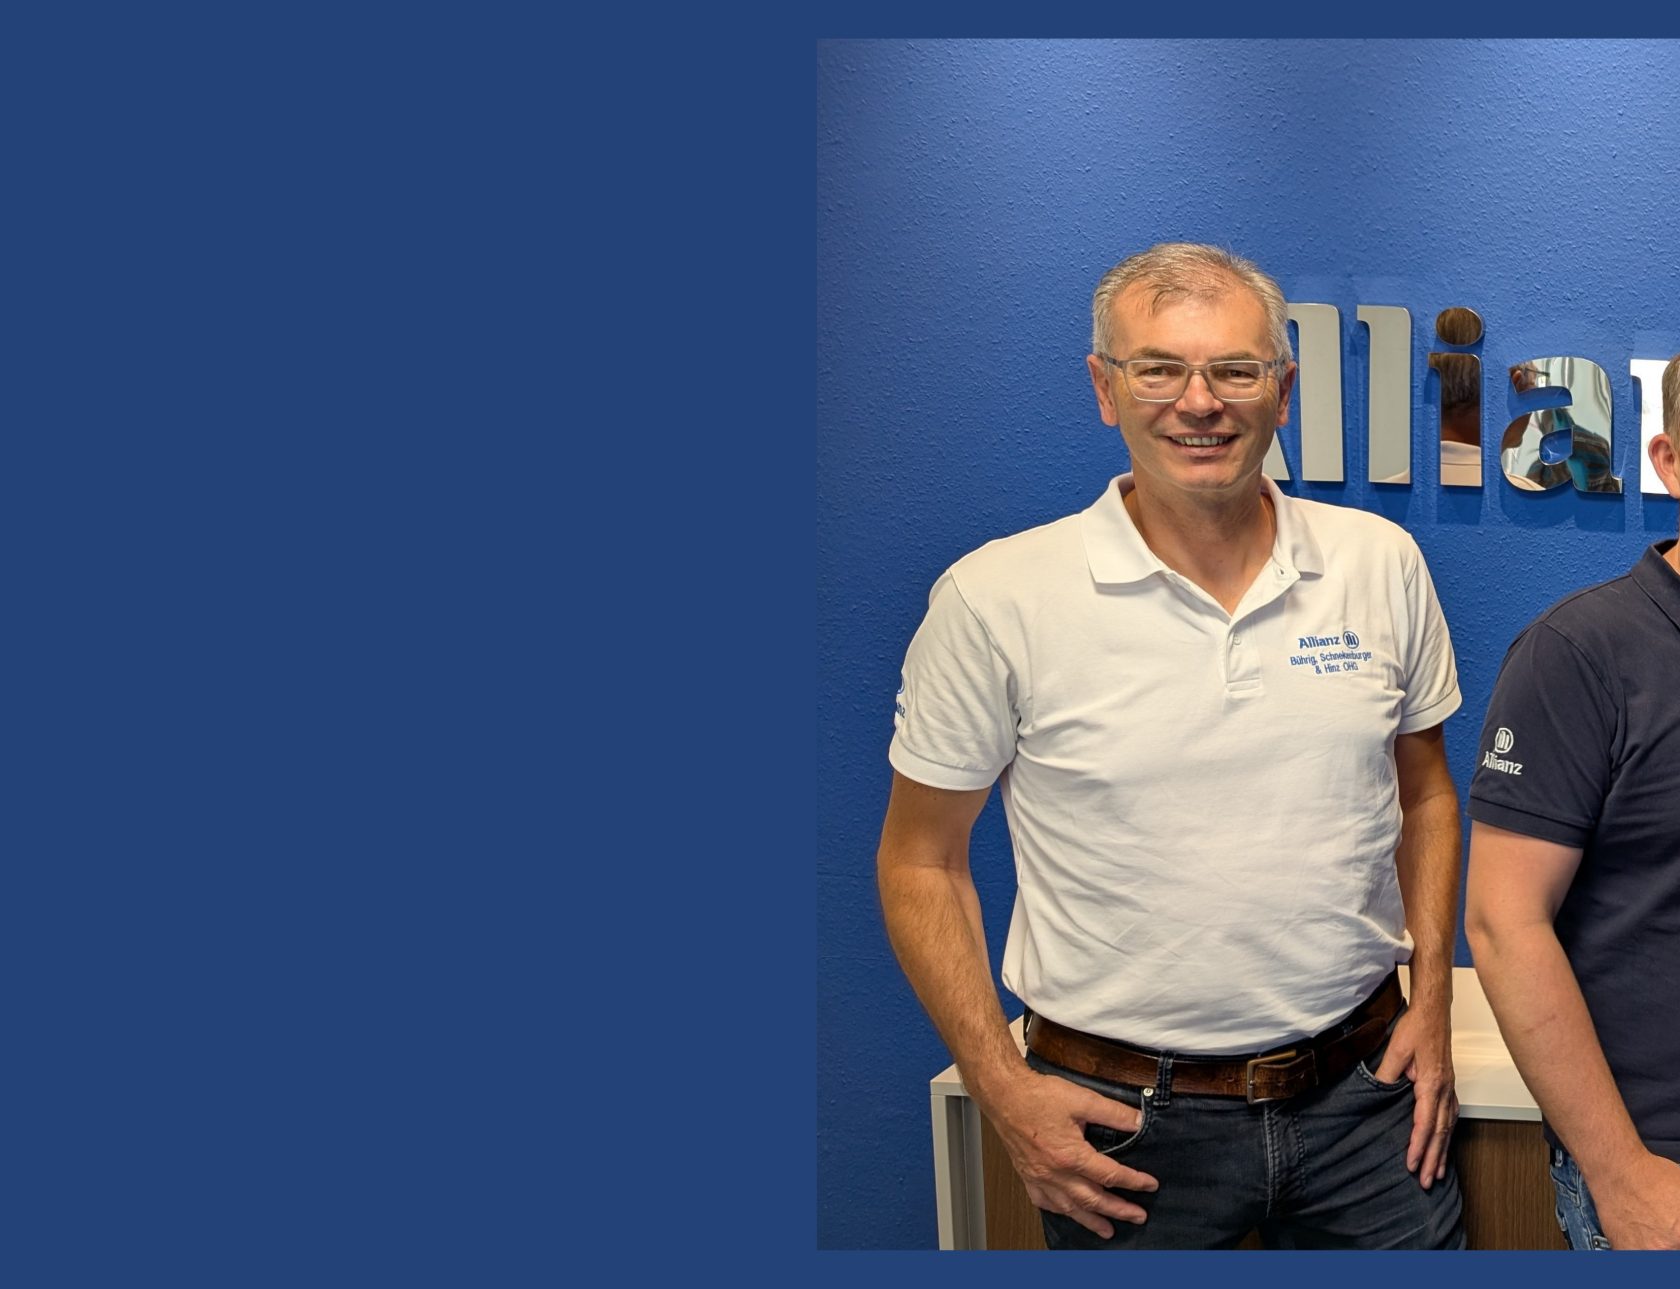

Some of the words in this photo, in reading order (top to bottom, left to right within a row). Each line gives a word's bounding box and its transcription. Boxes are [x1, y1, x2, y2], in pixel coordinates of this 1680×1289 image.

[1299, 635, 1341, 649] Allianz
[1315, 665, 1322, 674] &
[1324, 662, 1341, 673] Hinz
[1482, 751, 1523, 775] Allianz
